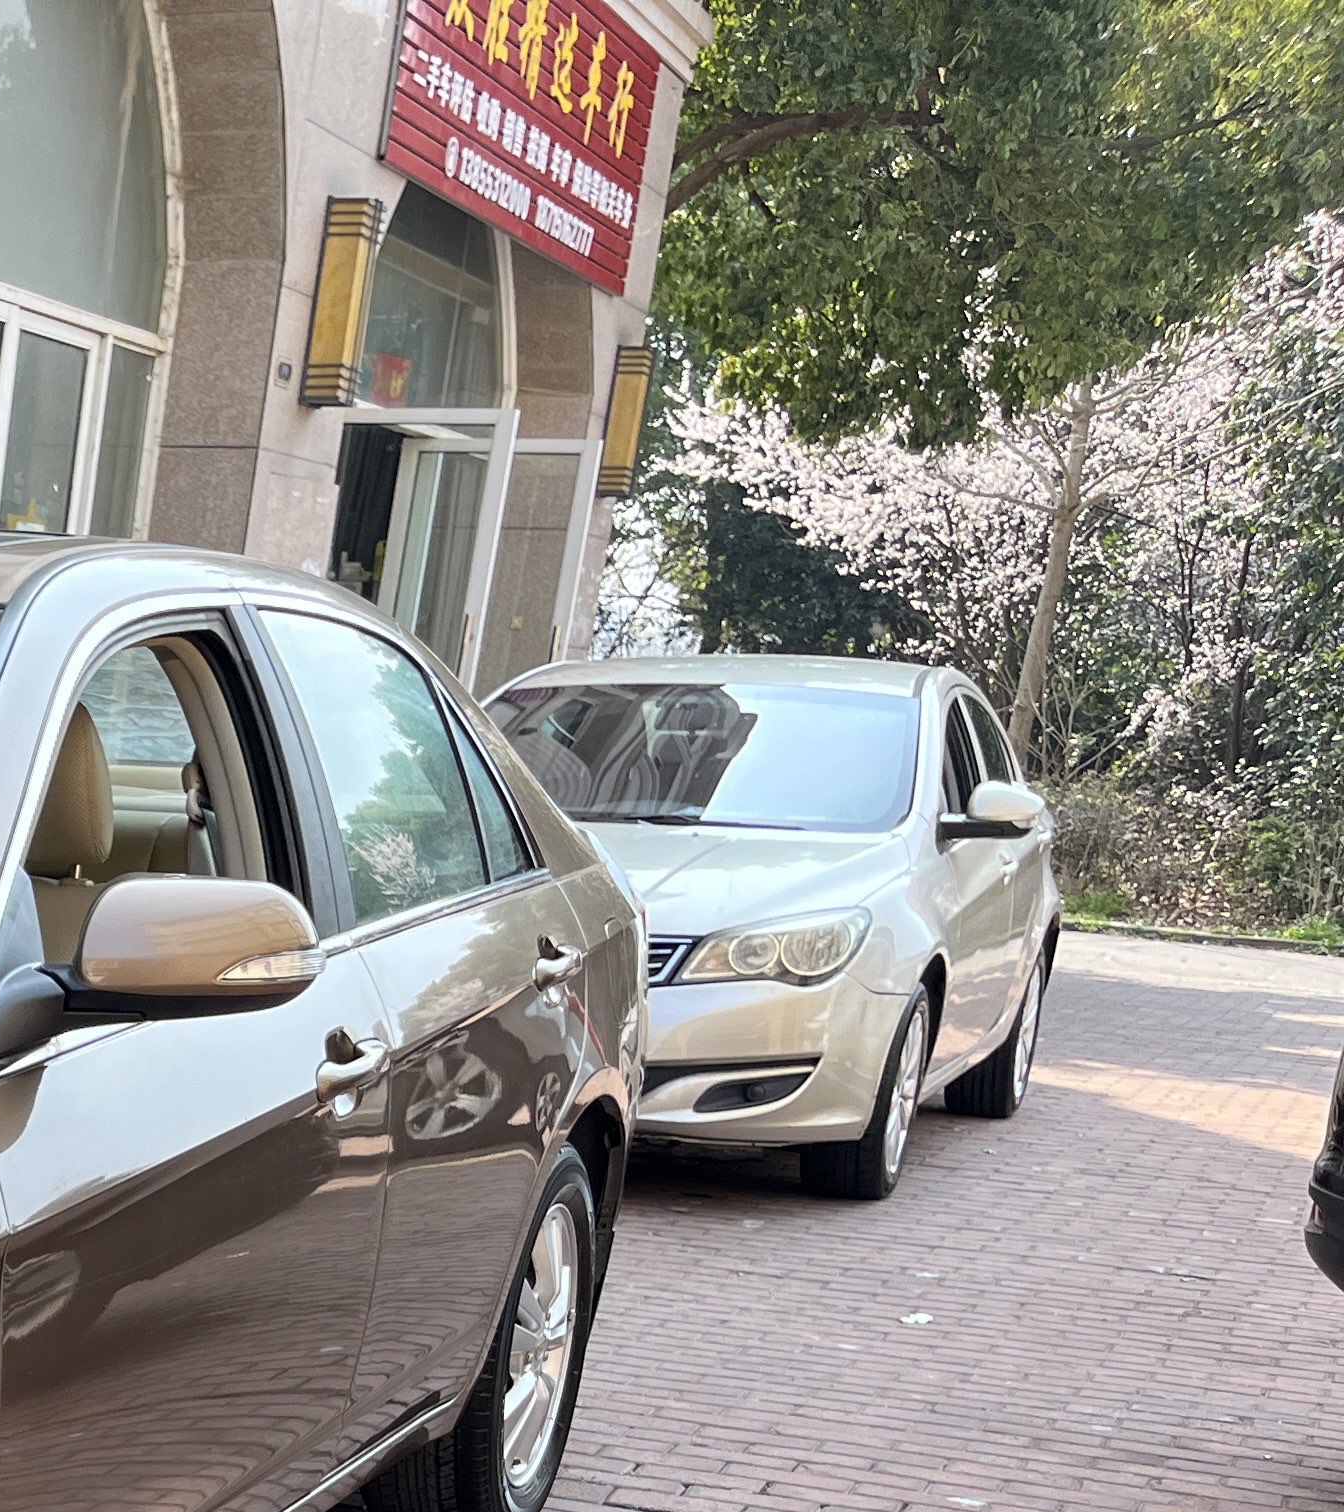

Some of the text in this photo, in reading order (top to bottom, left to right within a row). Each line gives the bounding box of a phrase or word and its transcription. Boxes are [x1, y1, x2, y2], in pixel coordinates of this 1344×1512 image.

[413, 49, 476, 125] 二手车评估
